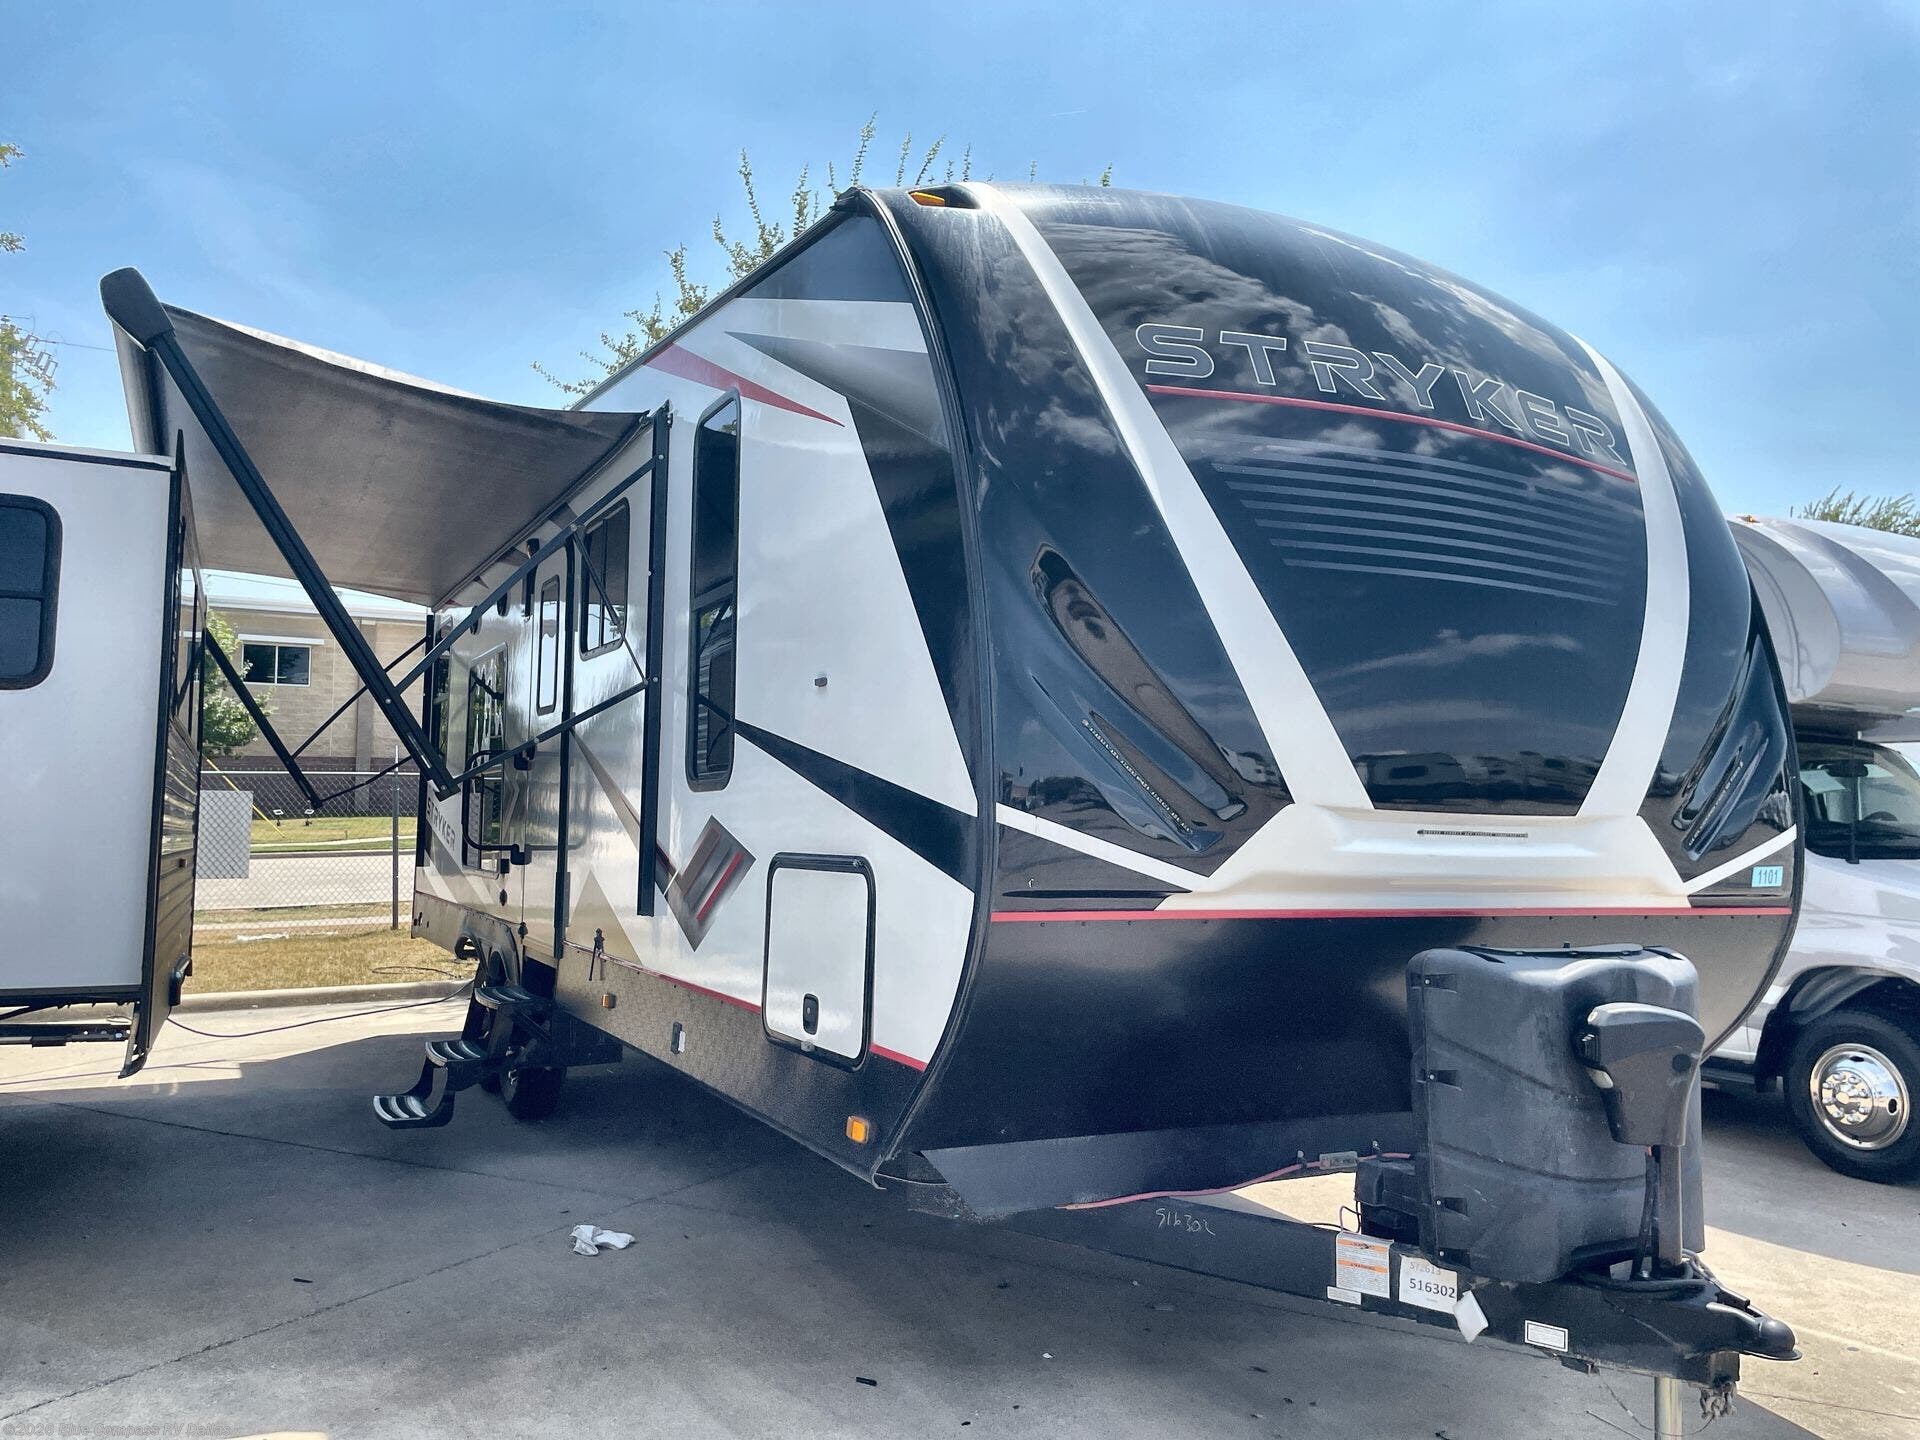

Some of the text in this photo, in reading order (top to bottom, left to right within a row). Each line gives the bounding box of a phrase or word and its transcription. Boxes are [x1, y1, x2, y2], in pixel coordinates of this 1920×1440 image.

[1135, 322, 1628, 466] STRYKER
[427, 797, 456, 852] STRYKER
[1758, 869, 1778, 884] 1101
[1409, 1278, 1456, 1299] 516302
